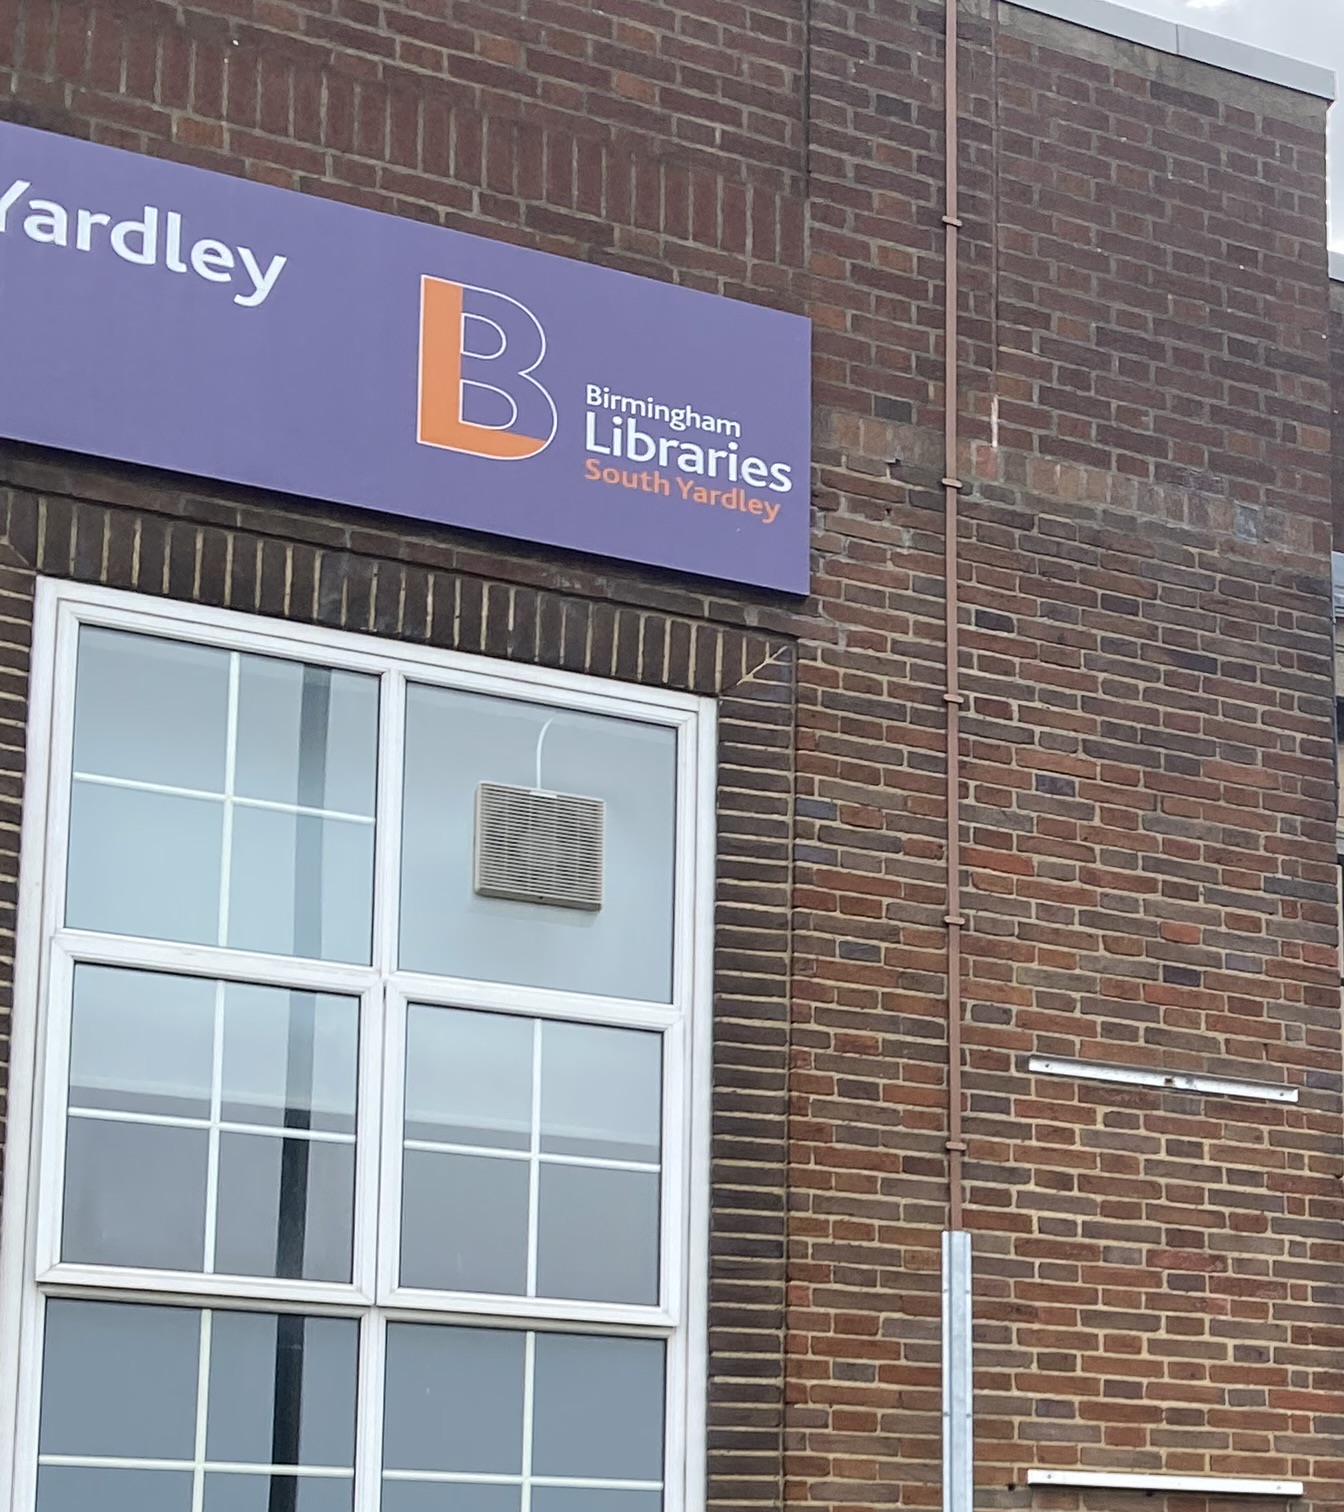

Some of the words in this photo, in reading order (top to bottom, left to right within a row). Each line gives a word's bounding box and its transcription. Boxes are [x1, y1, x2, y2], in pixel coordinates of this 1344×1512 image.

[0, 179, 288, 308] Yardley
[585, 383, 742, 438] Birmingham
[585, 410, 793, 493] Libraries
[583, 457, 671, 497] South
[674, 475, 782, 524] Yardley
